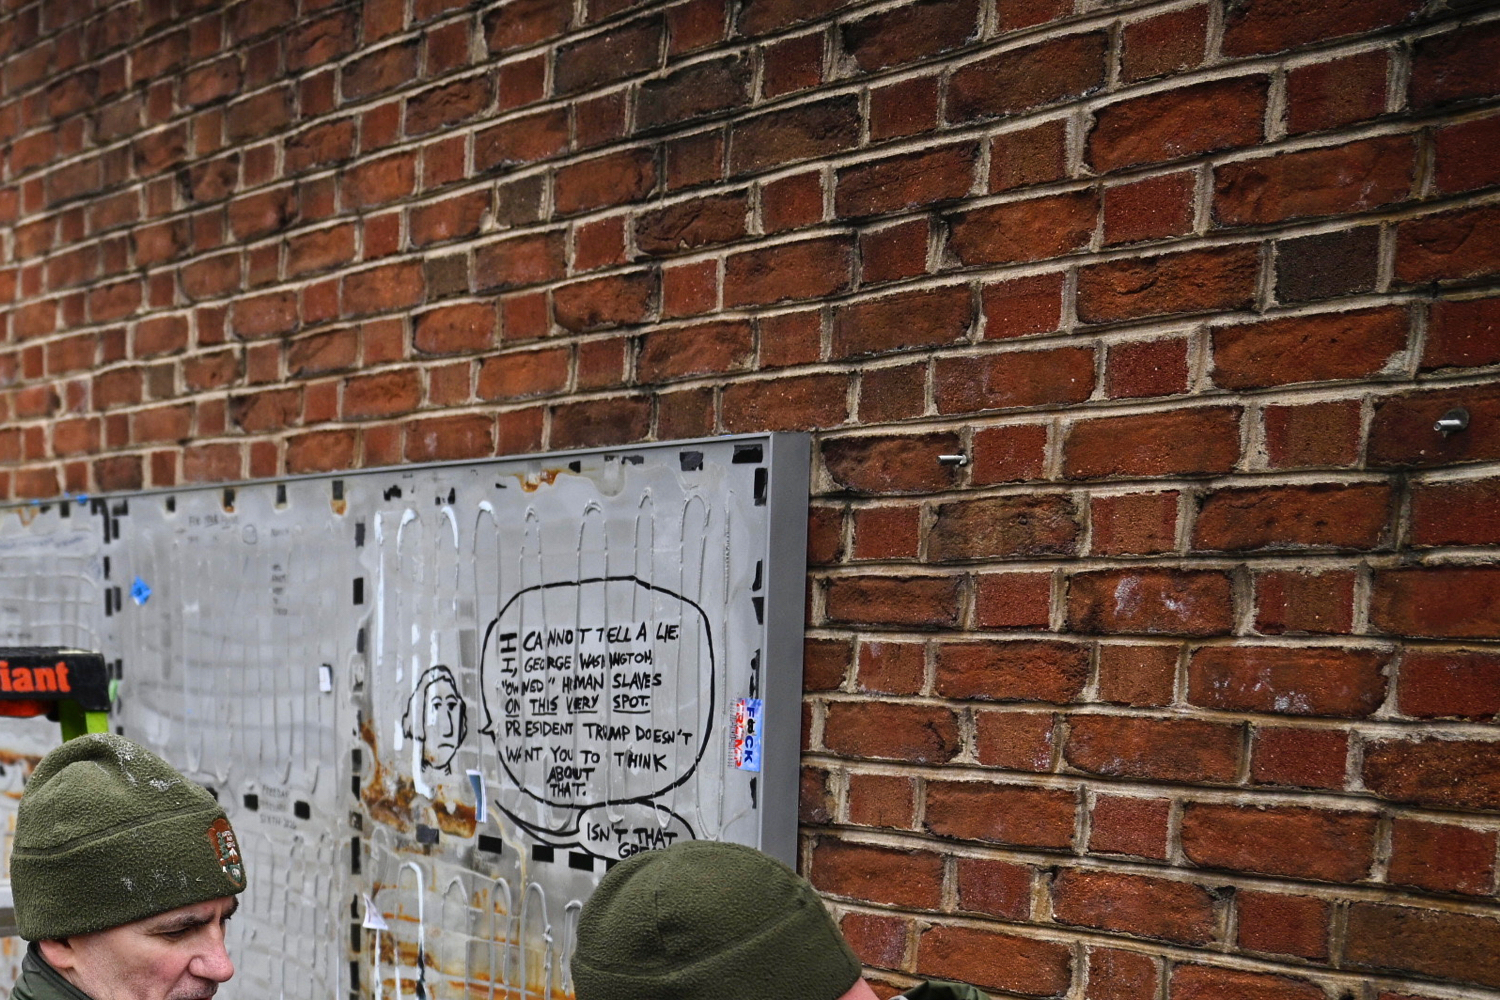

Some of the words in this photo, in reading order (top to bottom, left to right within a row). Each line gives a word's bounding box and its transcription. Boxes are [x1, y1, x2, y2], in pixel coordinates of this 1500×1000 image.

[500, 633, 517, 653] I
[523, 628, 592, 651] CANNOT
[596, 626, 631, 643] TELL
[636, 622, 646, 642] A
[656, 622, 679, 643] LIE.
[501, 657, 517, 677] I,
[525, 655, 572, 673] GEORGE
[612, 673, 662, 691] SLAVES
[505, 698, 521, 715] ON
[530, 695, 559, 713] THIS
[567, 694, 599, 711] VERY
[613, 695, 650, 710] SPOT.
[505, 720, 574, 738] PRESIDENT
[583, 723, 630, 741] TRUMP
[635, 725, 693, 745] DOESN'T
[550, 745, 574, 763] YOU
[580, 750, 600, 764] TO
[614, 750, 667, 772] THINK
[547, 766, 595, 783] ABOUT
[550, 783, 587, 798] THAT.
[587, 823, 628, 842] ISN'T
[633, 827, 678, 847] THAT
